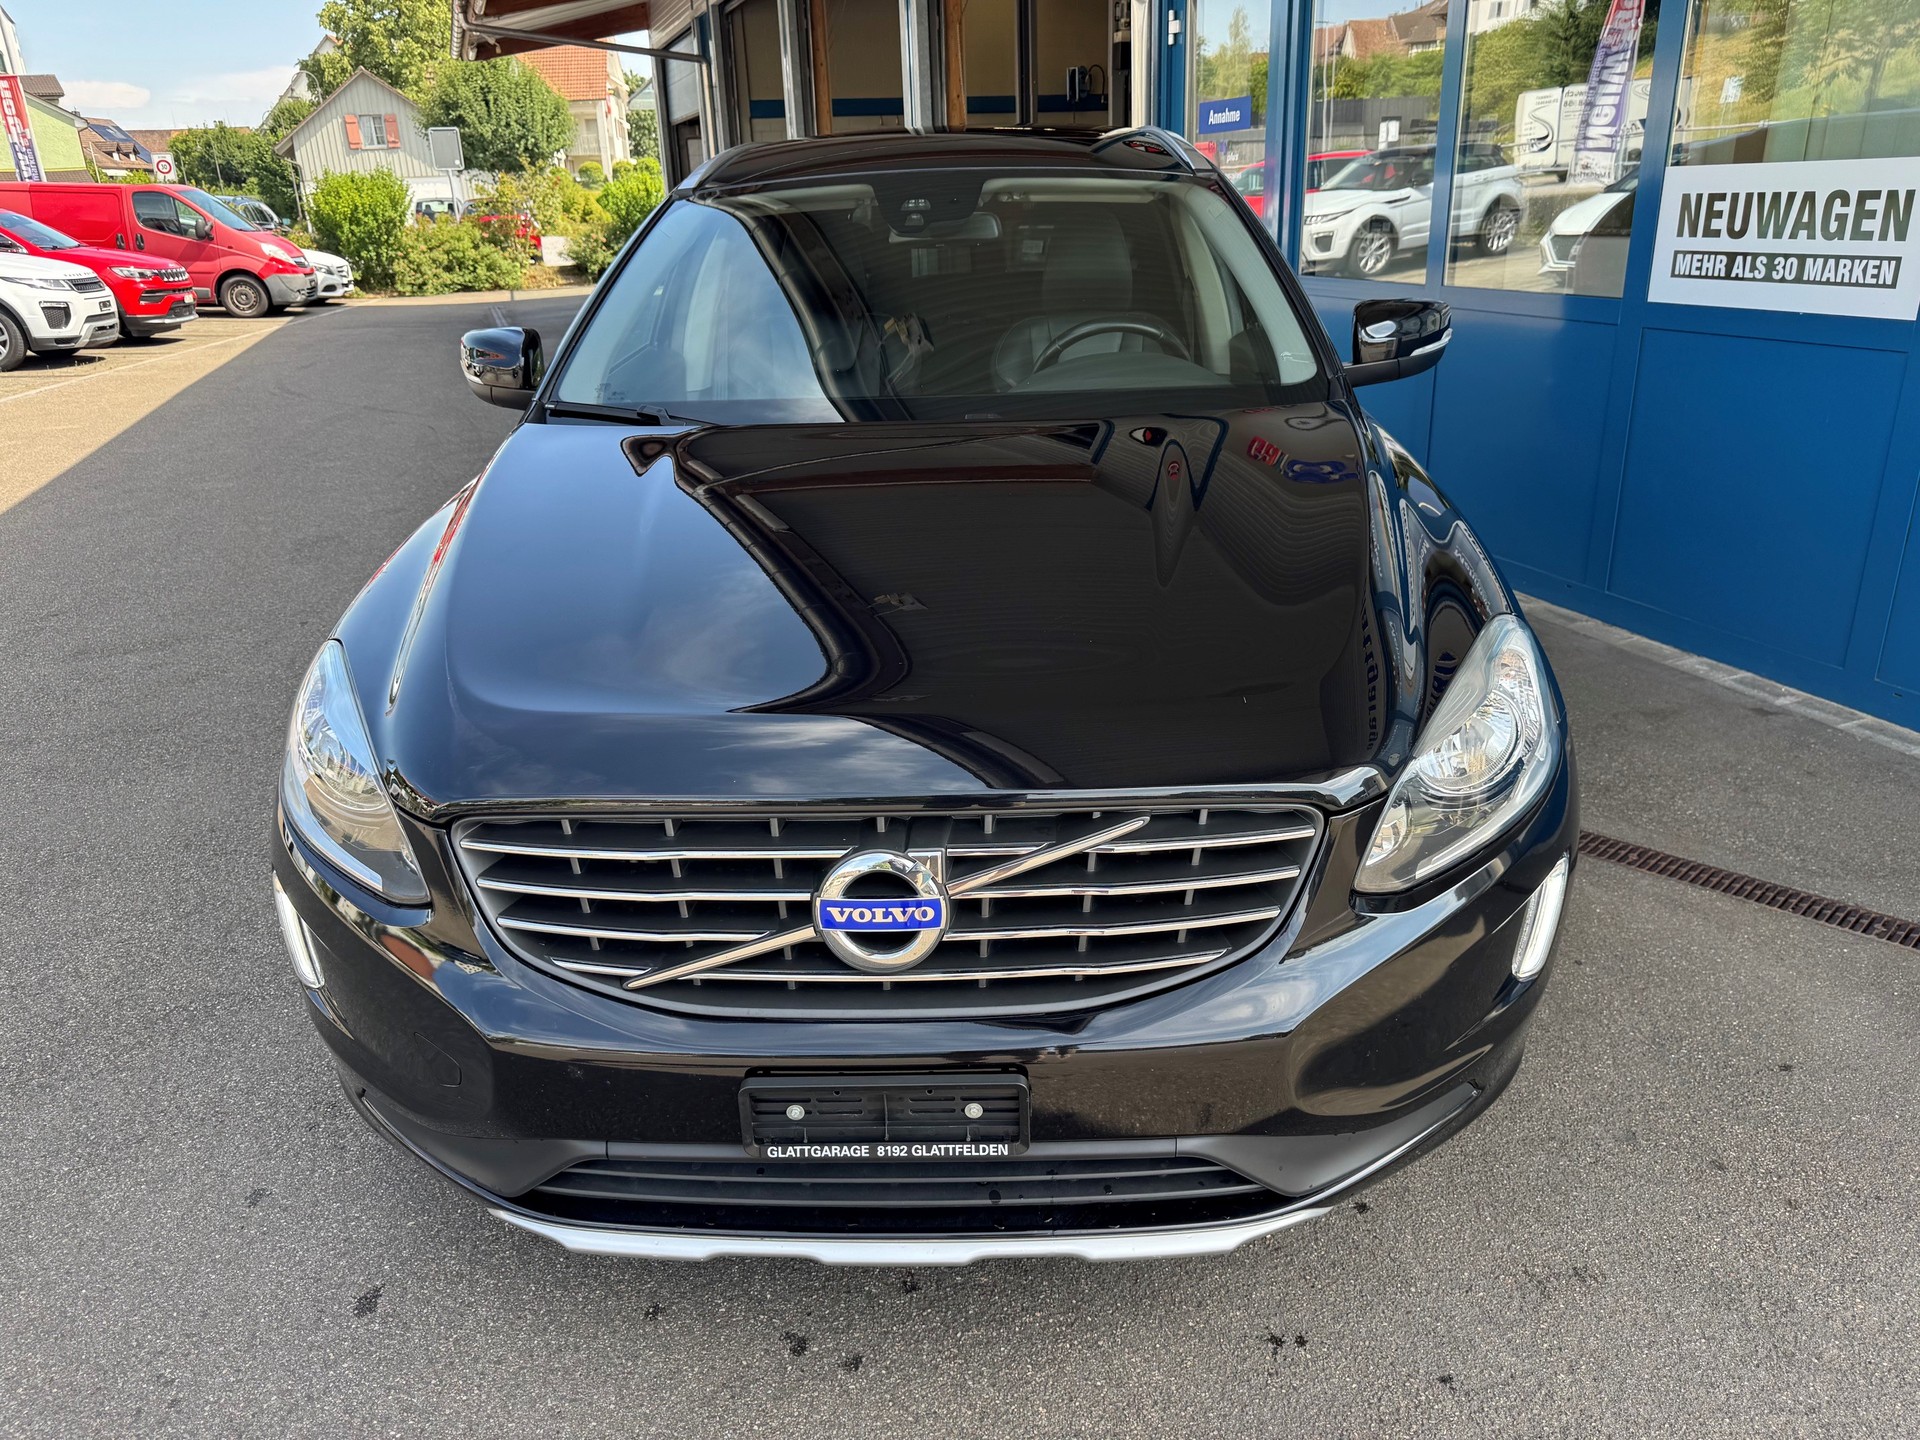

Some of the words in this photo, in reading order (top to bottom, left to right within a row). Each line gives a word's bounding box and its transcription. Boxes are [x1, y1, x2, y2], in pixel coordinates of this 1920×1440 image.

[1208, 107, 1241, 125] Annahme
[1676, 189, 1916, 242] NEUWAGEN
[1674, 253, 1728, 278] MEHR
[1730, 255, 1768, 280] ALS
[1772, 256, 1799, 281] 30
[1802, 257, 1897, 285] MARKEN
[826, 906, 935, 923] VOLVO
[767, 1145, 870, 1158] GLATTGARAGE
[876, 1144, 908, 1157] 8192
[911, 1143, 1009, 1156] GLATTFELDEN
